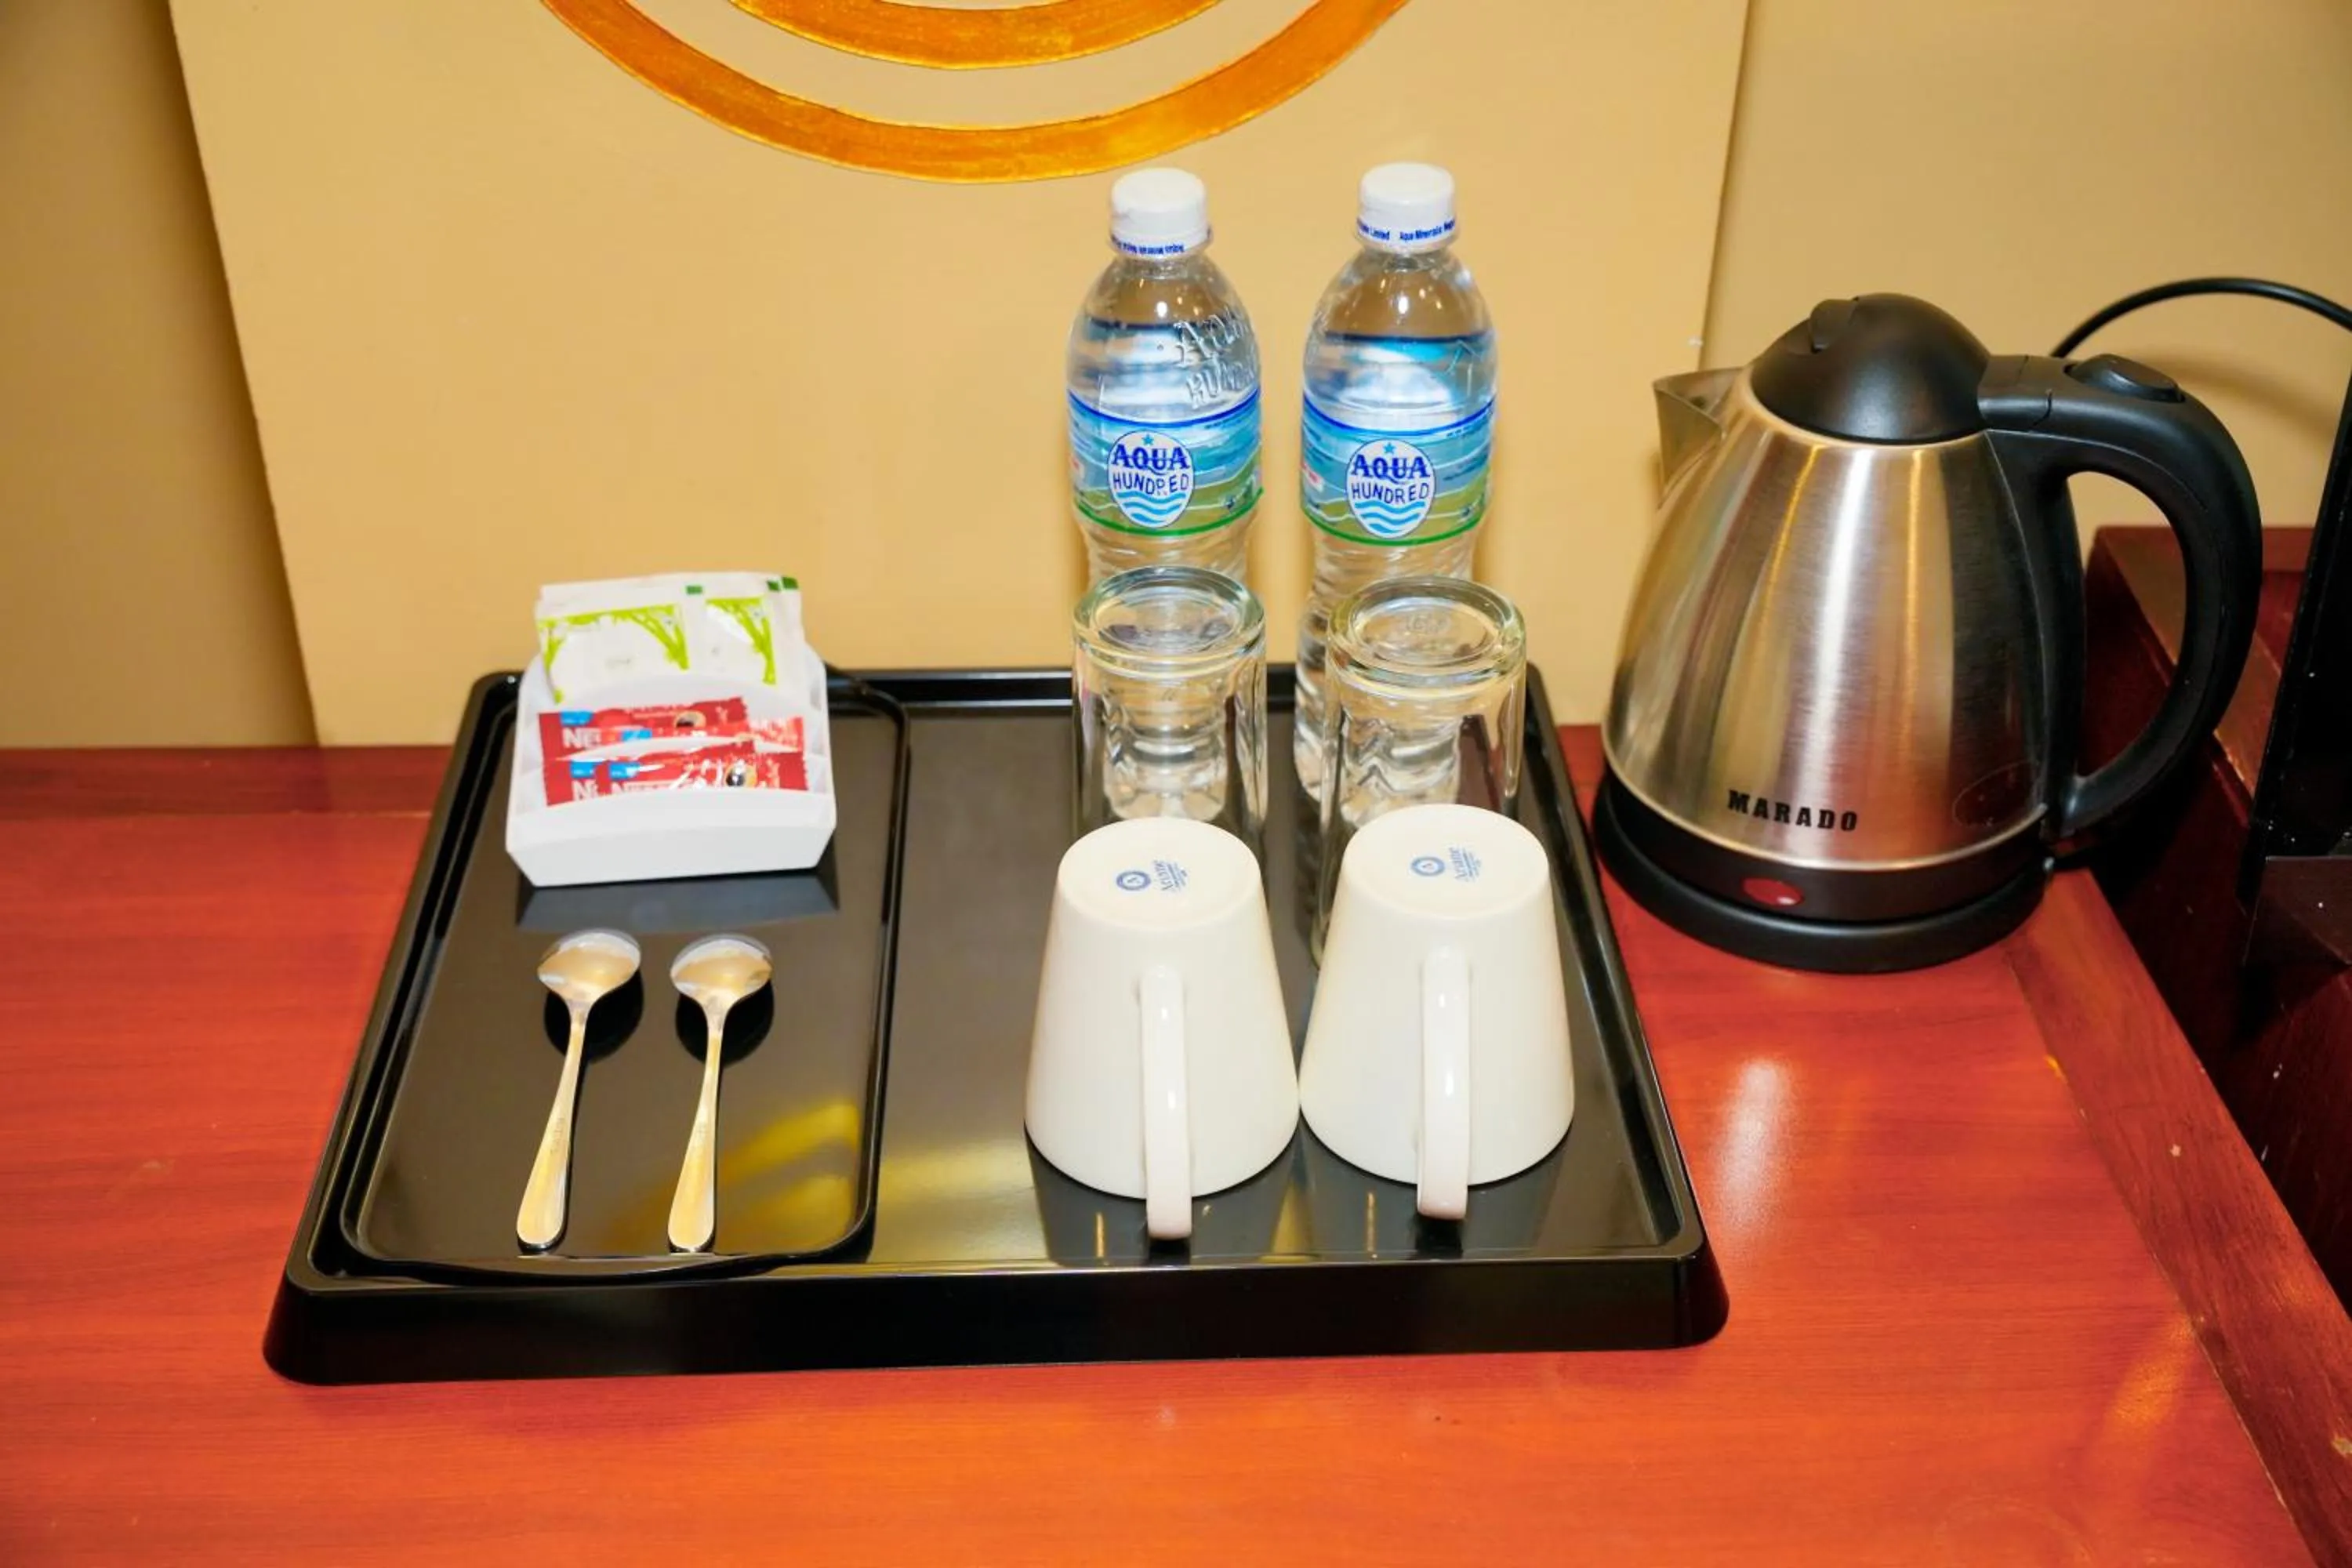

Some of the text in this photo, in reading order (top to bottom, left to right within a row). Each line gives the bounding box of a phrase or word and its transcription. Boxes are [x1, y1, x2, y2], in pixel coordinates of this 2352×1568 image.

[1111, 444, 1190, 476] AQUA
[1351, 454, 1431, 485] AQUA
[1112, 473, 1189, 495] HUNDRED
[1352, 481, 1430, 504] HUNDRED
[1728, 789, 1858, 831] MARADO
